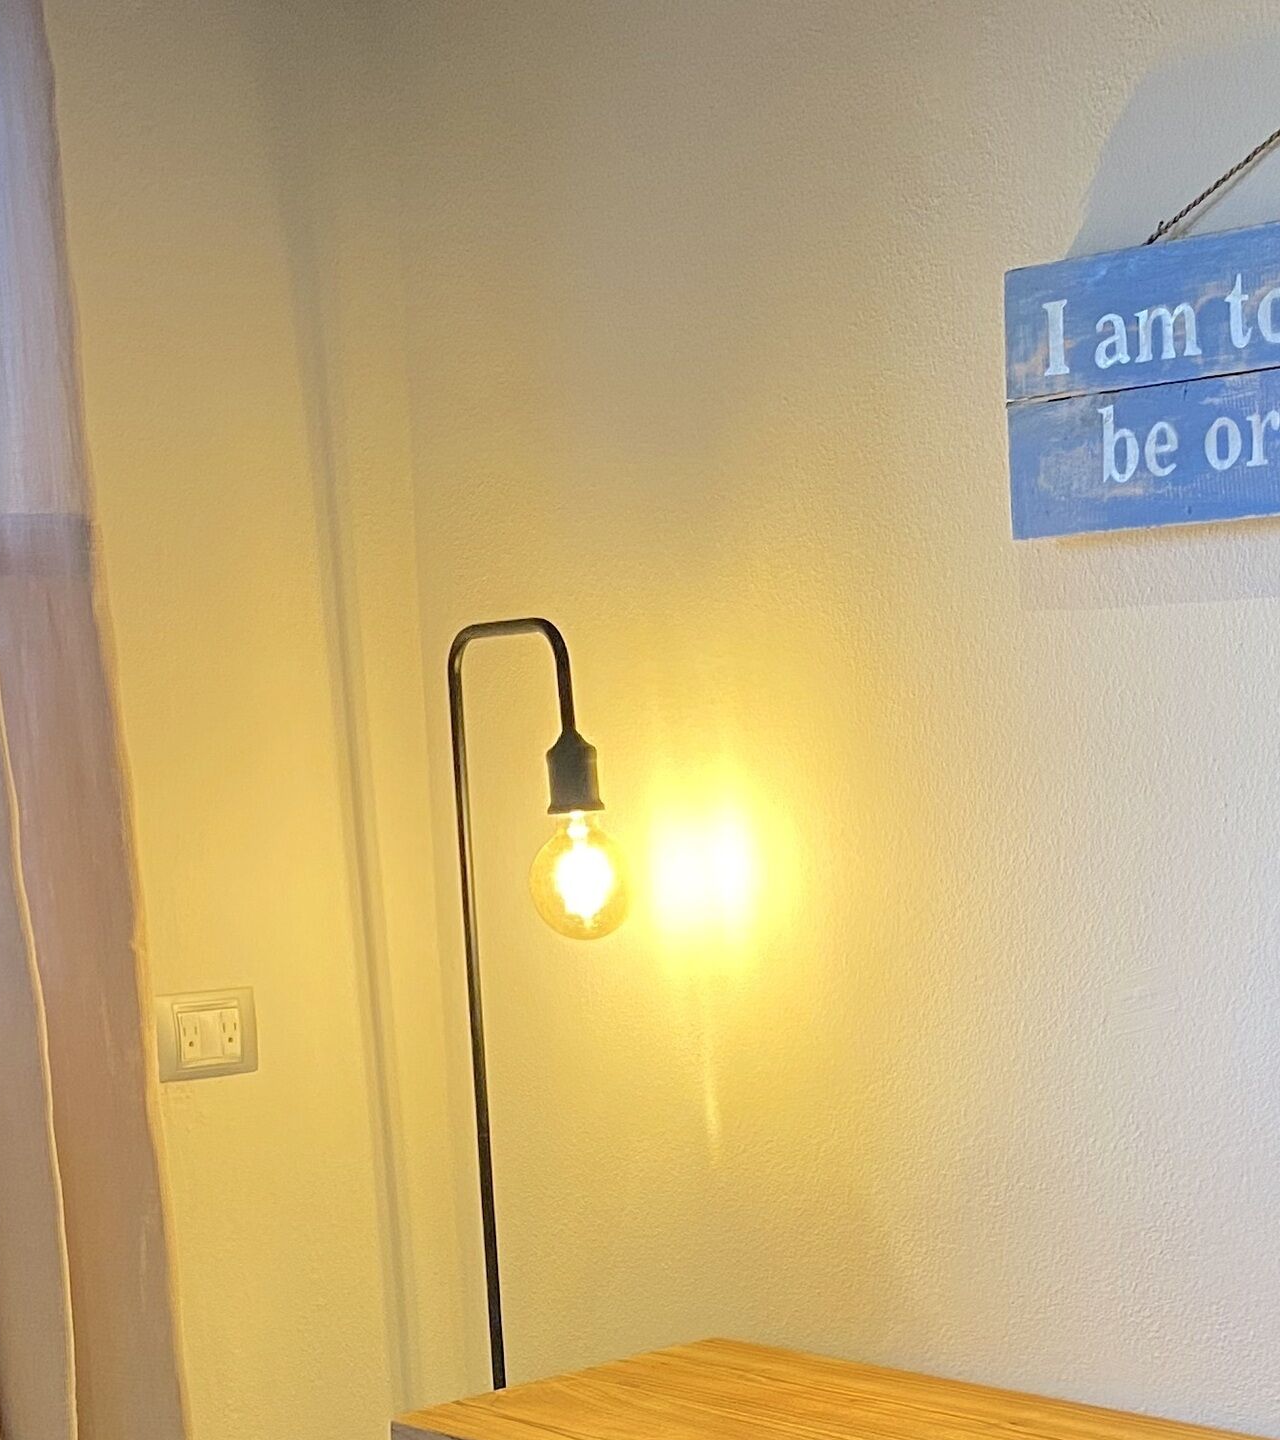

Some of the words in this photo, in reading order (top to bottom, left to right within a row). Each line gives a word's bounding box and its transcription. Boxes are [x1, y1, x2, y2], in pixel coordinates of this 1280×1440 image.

[1041, 298, 1071, 378] I
[1093, 300, 1199, 370] am
[1097, 406, 1177, 484] be
